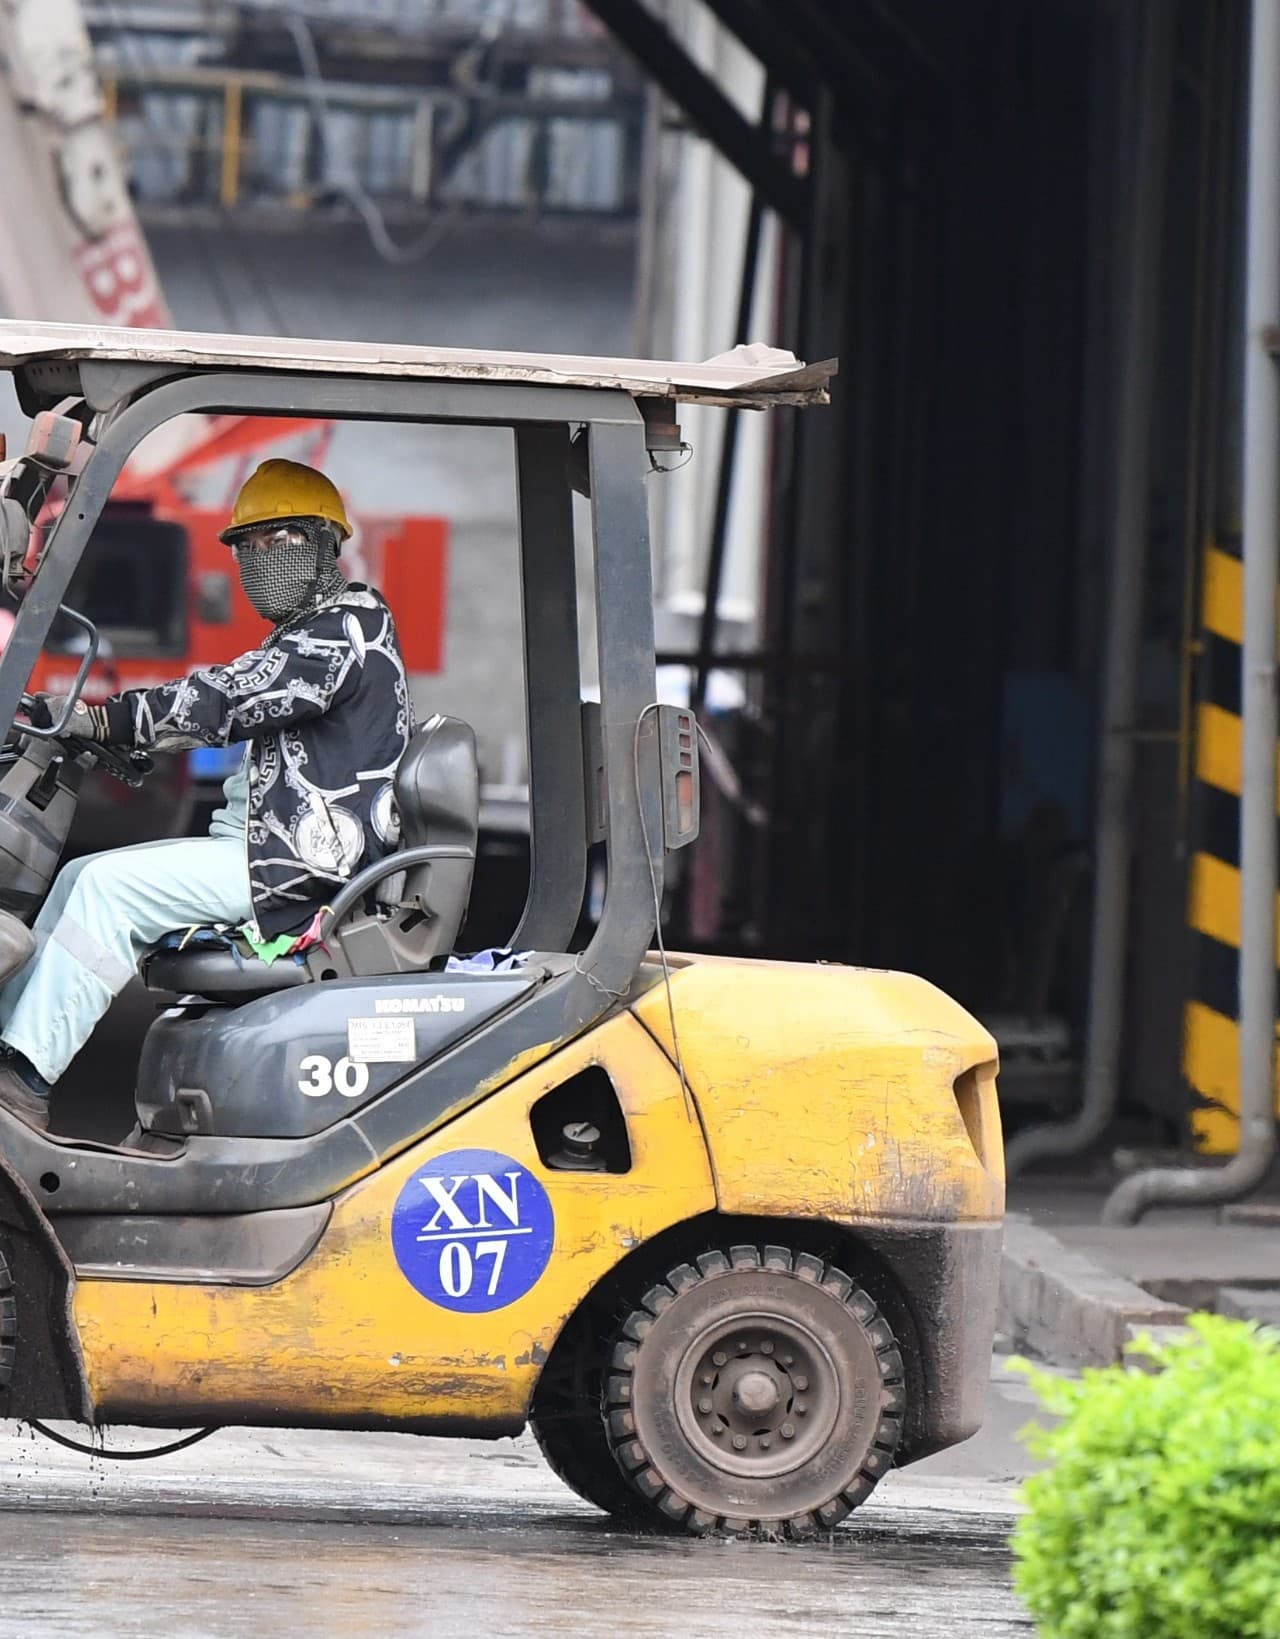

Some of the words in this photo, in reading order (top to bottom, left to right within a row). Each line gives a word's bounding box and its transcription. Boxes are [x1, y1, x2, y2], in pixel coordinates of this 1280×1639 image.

[375, 995, 465, 1013] KOMATSU
[298, 1055, 369, 1097] 30
[418, 1171, 522, 1231] XN
[439, 1240, 508, 1298] 07
